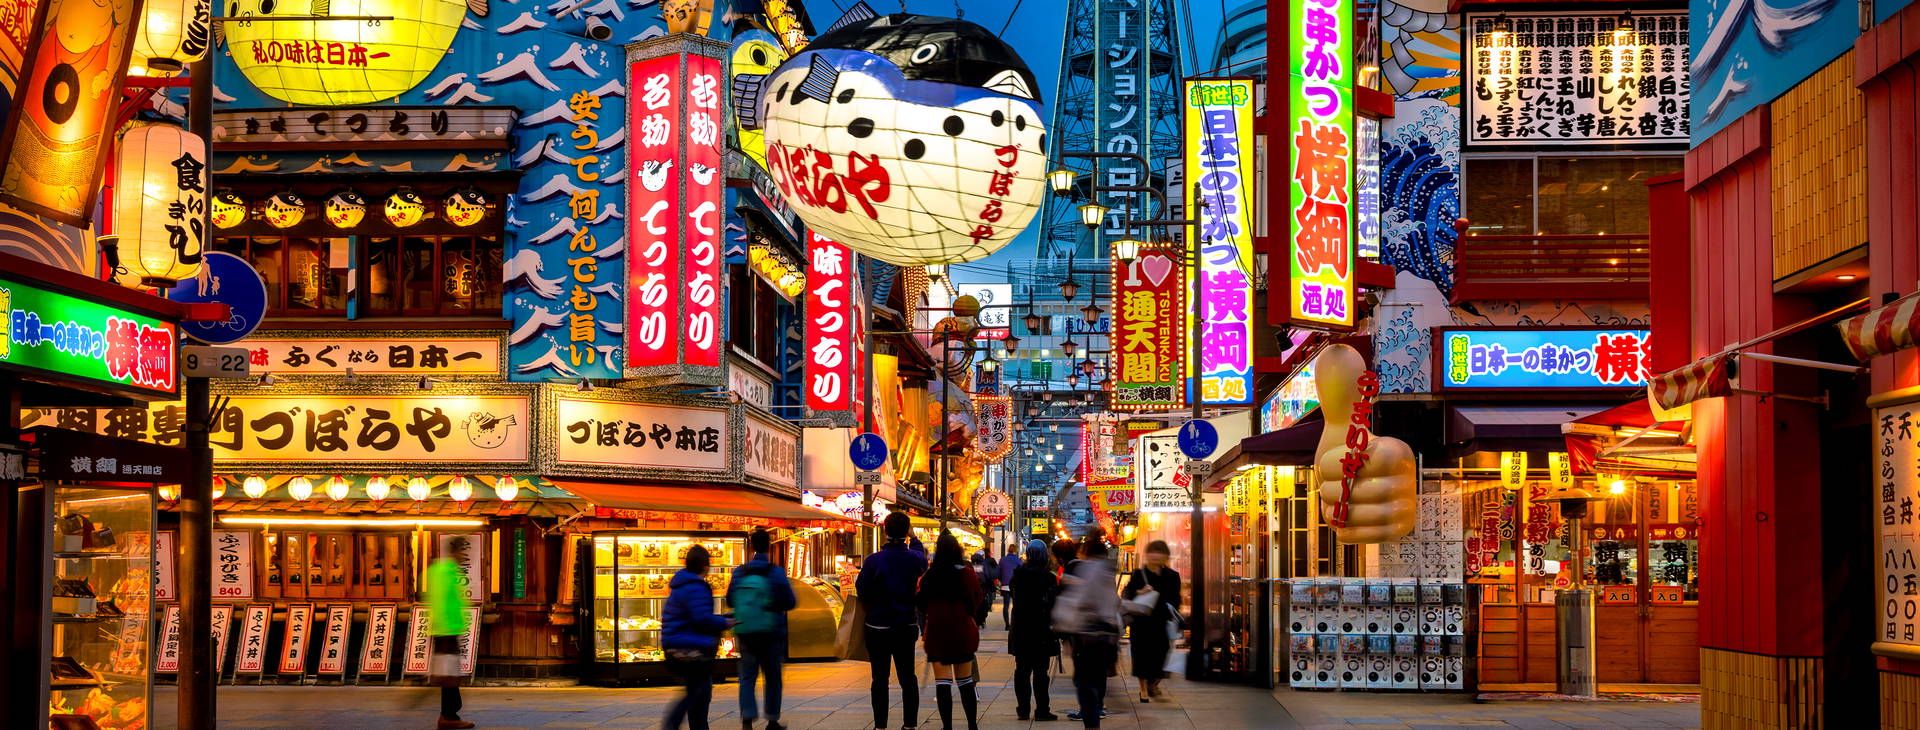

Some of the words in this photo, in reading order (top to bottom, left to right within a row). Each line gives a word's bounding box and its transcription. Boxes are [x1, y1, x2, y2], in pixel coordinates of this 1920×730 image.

[252, 40, 391, 67] 私の味は日本一
[642, 73, 671, 148] 名物
[690, 73, 718, 148] 名物
[1106, 0, 1139, 235] ーションの日立
[1191, 85, 1248, 106] 新世界
[1476, 77, 1493, 138] もち
[1496, 77, 1514, 138] うずら玉子
[1516, 77, 1534, 138] 紅しょうが
[1536, 77, 1554, 138] にんにく
[1556, 77, 1575, 138] 玉ねぎ
[1577, 77, 1595, 138] 山芋
[1597, 77, 1616, 138] しし唐
[1618, 77, 1636, 138] れんこん
[1638, 77, 1657, 138] 銀杏
[1658, 77, 1677, 138] 白ねぎ
[767, 139, 890, 220] づぼらや
[969, 143, 1022, 245] づぼらや
[1200, 110, 1239, 265] 日本一の串かつ
[1295, 120, 1349, 279] 横綱
[568, 90, 601, 367] 安うて何んでも旨い
[1302, 283, 1346, 318] 酒処
[10, 309, 104, 359] 日本一の串かつ
[105, 315, 173, 389] 横綱
[1123, 291, 1157, 384] 通天閣
[1159, 290, 1171, 382] TSUTENKAKU
[1452, 337, 1468, 382] 新世界
[1471, 346, 1592, 372] 日本一の串かつ
[1594, 335, 1650, 383] 横
[567, 419, 719, 453] づぼらや本店
[991, 403, 1008, 443] 串かつ
[71, 456, 118, 475] 横綱
[219, 587, 242, 596] 840
[1609, 592, 1630, 602] 入口
[1658, 592, 1678, 602] 入口
